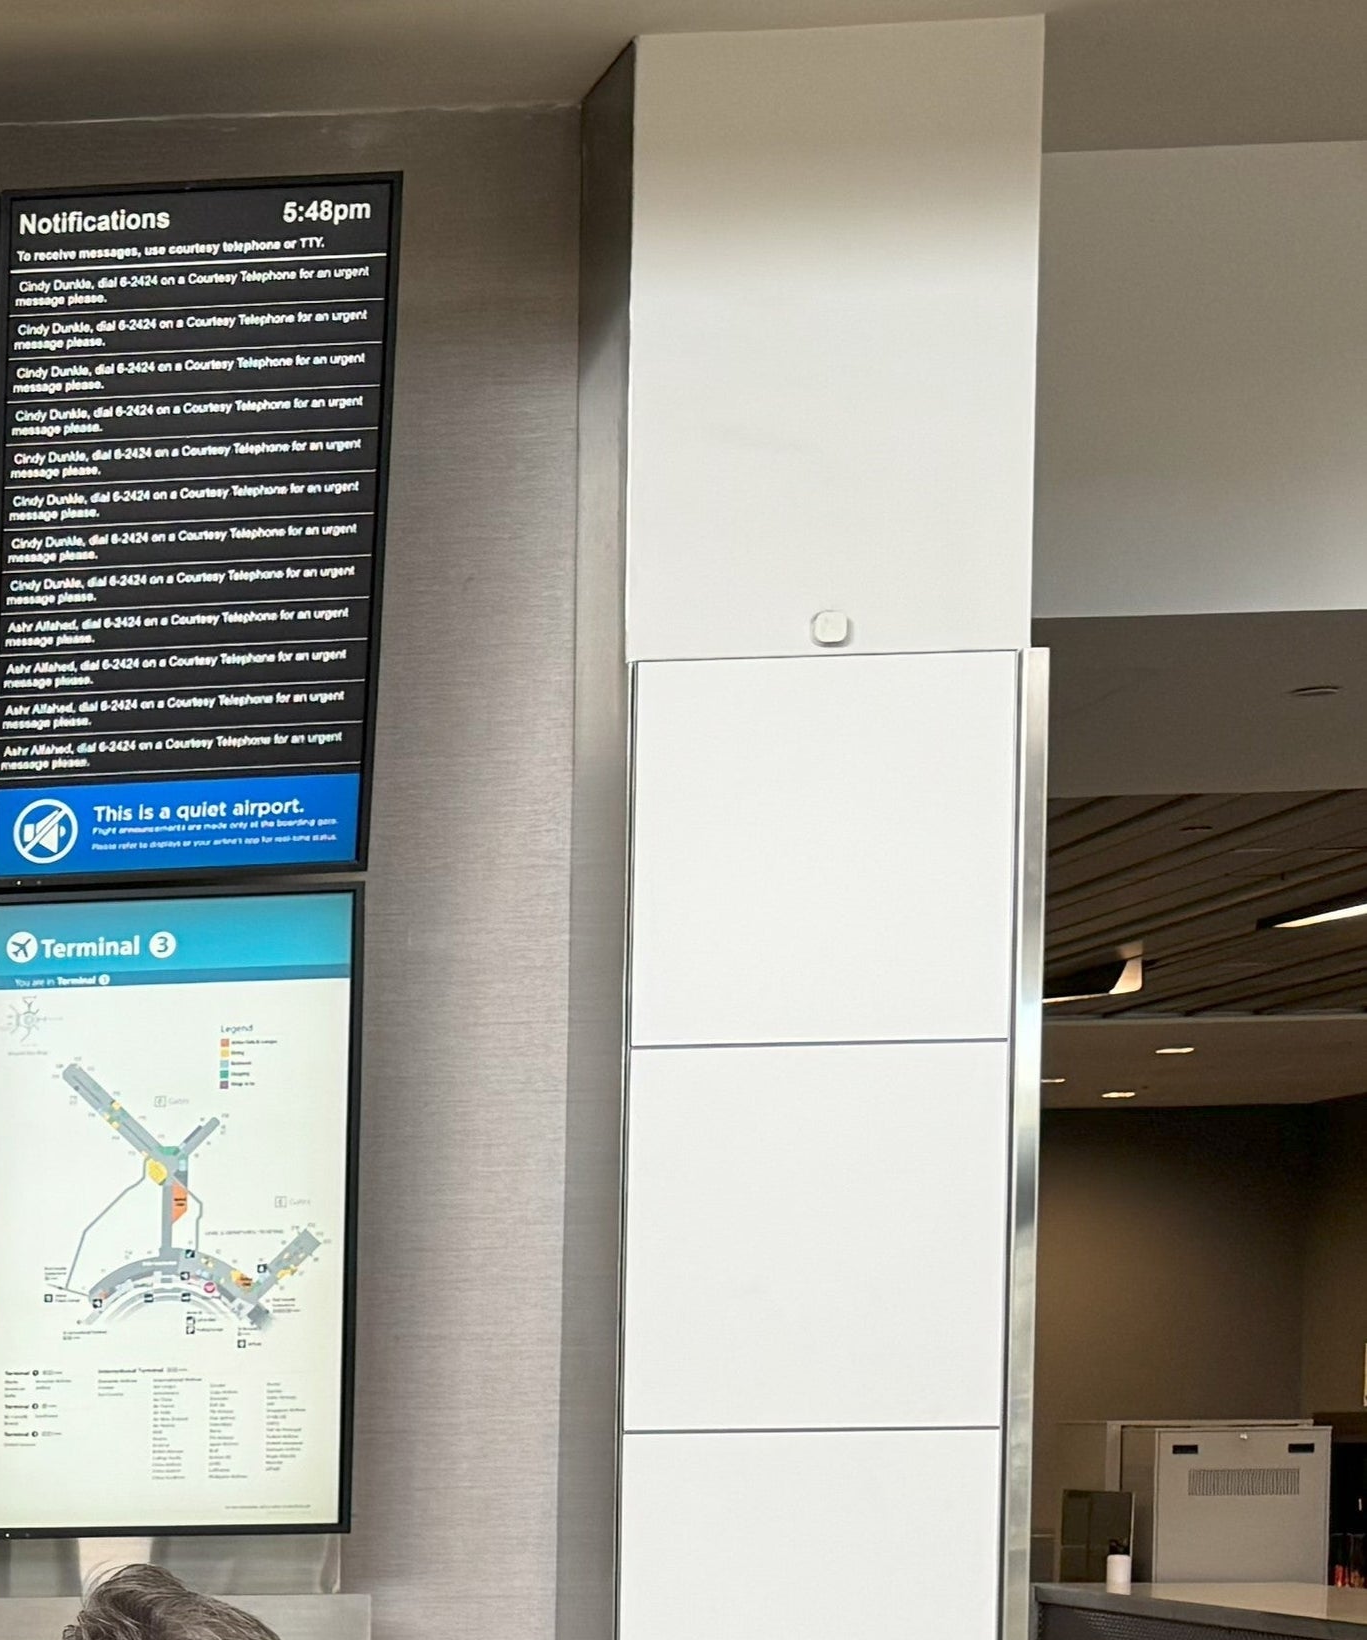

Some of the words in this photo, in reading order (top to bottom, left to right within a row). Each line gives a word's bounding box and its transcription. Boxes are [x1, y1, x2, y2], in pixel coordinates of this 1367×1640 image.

[19, 208, 170, 235] Notifications
[282, 199, 370, 226] 5:48pm
[16, 250, 31, 262] To
[33, 248, 76, 262] receive
[78, 247, 141, 260] messages,
[144, 246, 166, 256] use
[168, 242, 220, 256] courtesy
[222, 239, 281, 254] telephone
[283, 239, 297, 250] or
[299, 236, 324, 249] TTY.
[18, 280, 51, 294] Cindy
[97, 276, 117, 289] dial
[160, 276, 175, 286] on
[177, 275, 185, 285] a
[187, 272, 237, 286] Courtesy
[239, 269, 296, 284] Telephone
[299, 267, 315, 280] for
[333, 265, 369, 280] urgent
[15, 295, 65, 308] message
[93, 804, 132, 823] This
[138, 803, 153, 821] is
[158, 806, 170, 820] a
[176, 801, 226, 822] quiet
[232, 798, 304, 818] airport.
[40, 934, 139, 959] Terminal
[156, 936, 169, 952] 3
[56, 975, 96, 986] Terminal
